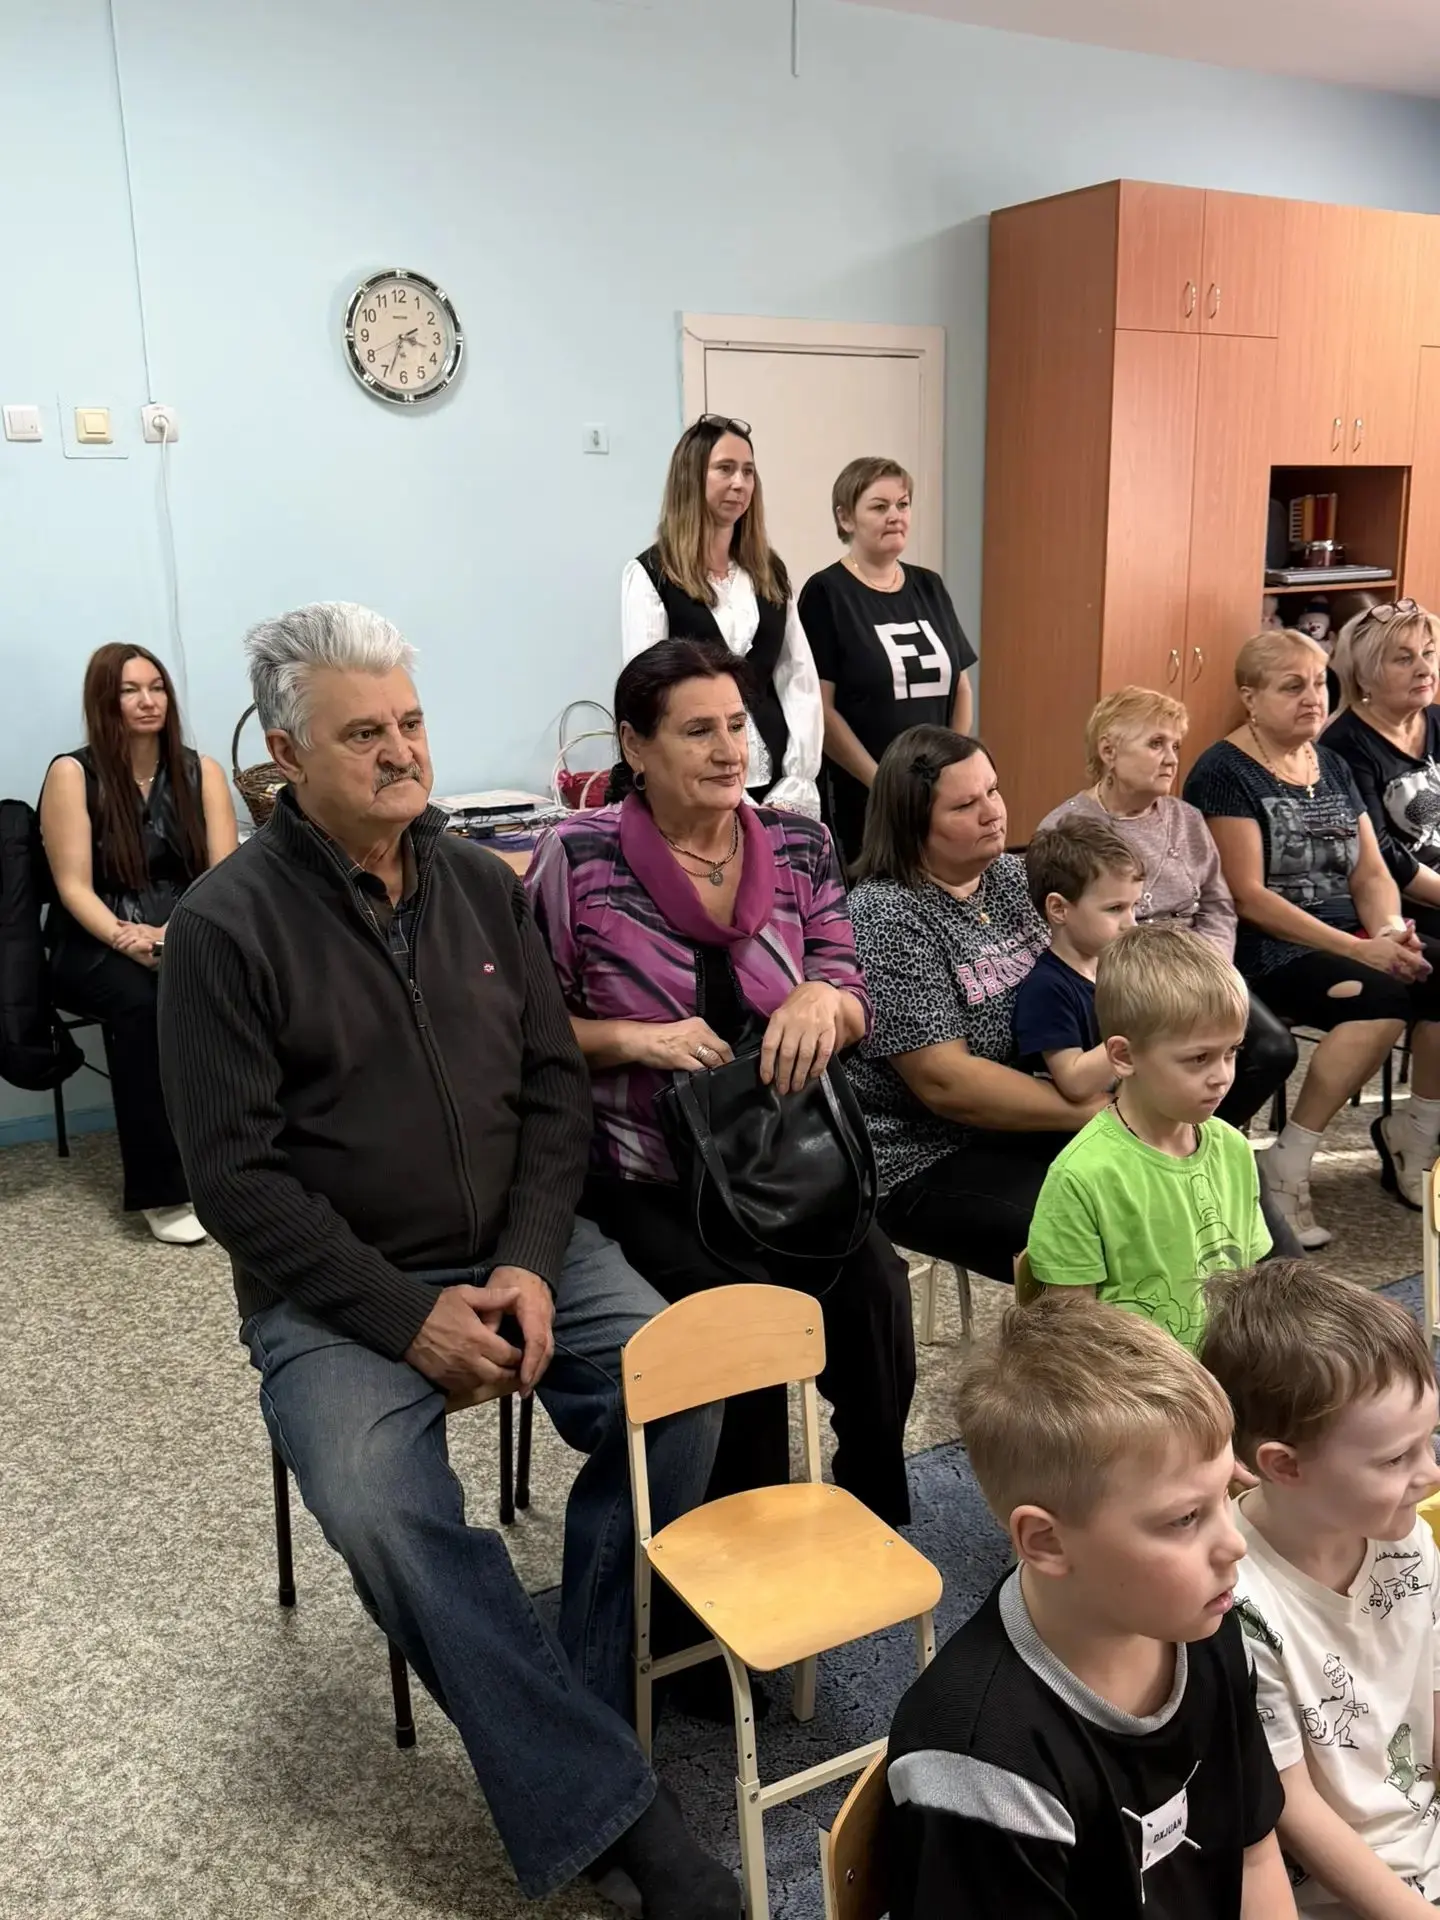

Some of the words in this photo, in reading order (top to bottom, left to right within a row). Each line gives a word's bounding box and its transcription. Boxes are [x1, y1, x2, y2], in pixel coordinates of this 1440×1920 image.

[375, 294, 388, 309] 11
[391, 289, 407, 304] 12
[414, 296, 421, 310] 1
[362, 308, 377, 323] 10
[426, 311, 436, 326] 2
[360, 328, 370, 343] 9
[432, 331, 442, 346] 3
[367, 349, 376, 363] 8
[429, 352, 438, 366] 4
[380, 364, 389, 378] 7
[399, 370, 409, 384] 6
[417, 366, 426, 380] 5
